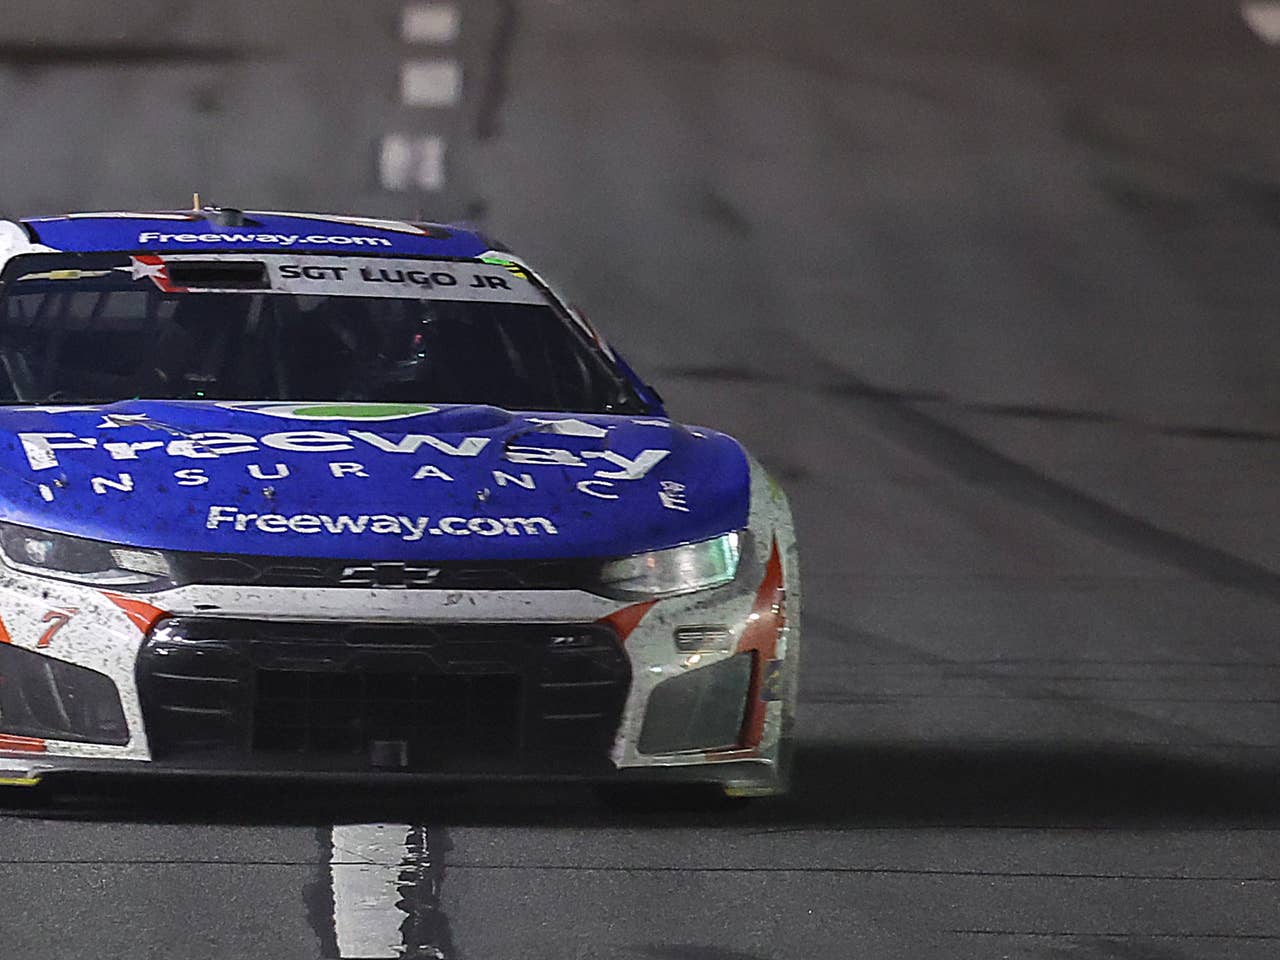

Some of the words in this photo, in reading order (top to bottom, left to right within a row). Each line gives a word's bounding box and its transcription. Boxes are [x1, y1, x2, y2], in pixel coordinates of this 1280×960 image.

[139, 231, 392, 249] Freeway.com
[280, 264, 350, 282] SGT
[360, 267, 458, 288] LUGO
[469, 272, 513, 291] JR
[17, 429, 672, 480] Freeway
[38, 462, 691, 513] INSURANCE
[205, 505, 560, 541] Freeway.com
[41, 606, 81, 649] 7
